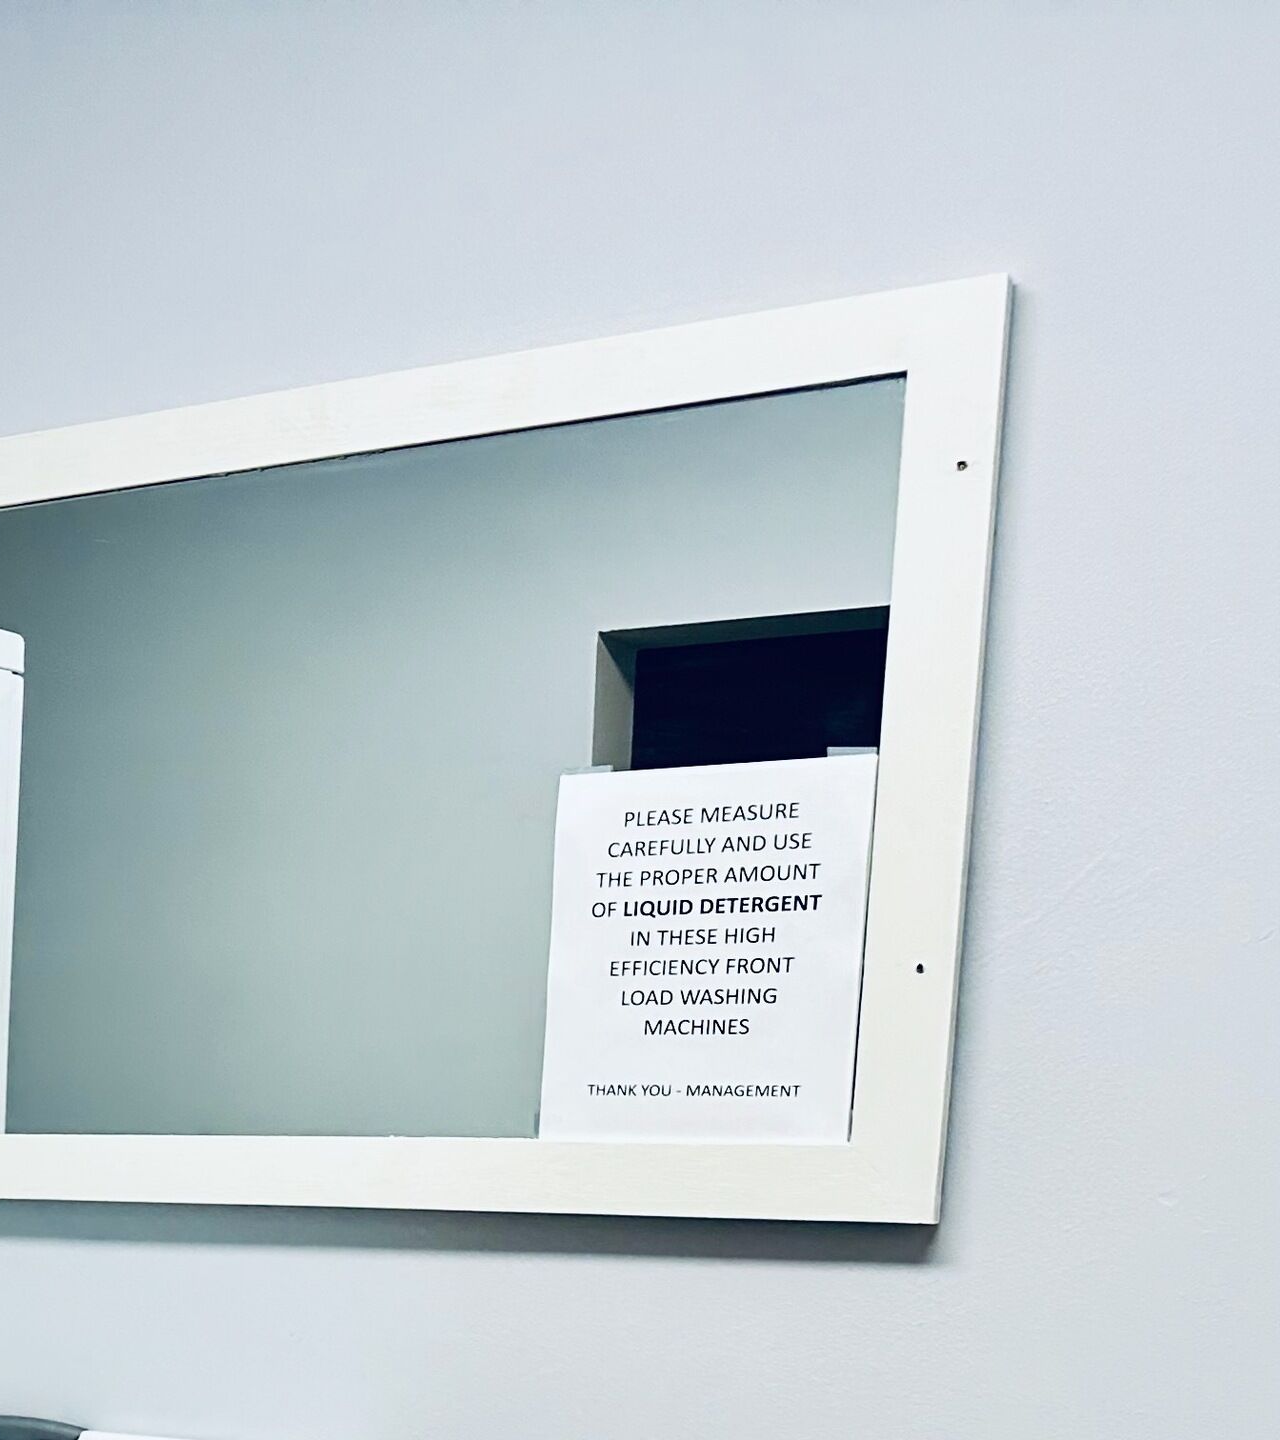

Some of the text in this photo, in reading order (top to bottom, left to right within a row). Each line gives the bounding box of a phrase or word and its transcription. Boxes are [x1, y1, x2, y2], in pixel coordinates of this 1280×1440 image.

[625, 803, 799, 827] PLEASE MEASURE
[608, 833, 812, 857] CAREFULLY AND USE
[597, 864, 821, 888] THE PROPER AMOUNT
[592, 894, 822, 918] OF LIQUID DETERGENT
[631, 927, 775, 946] IN THESE HIGH
[610, 957, 795, 976] EFFICIENCY FRONT
[622, 988, 777, 1005] LOAD WASHING
[645, 1019, 749, 1035] MACHINES
[588, 1085, 636, 1096] THANK
[642, 1085, 671, 1096] YOU
[687, 1085, 800, 1096] MANAGEMENT
